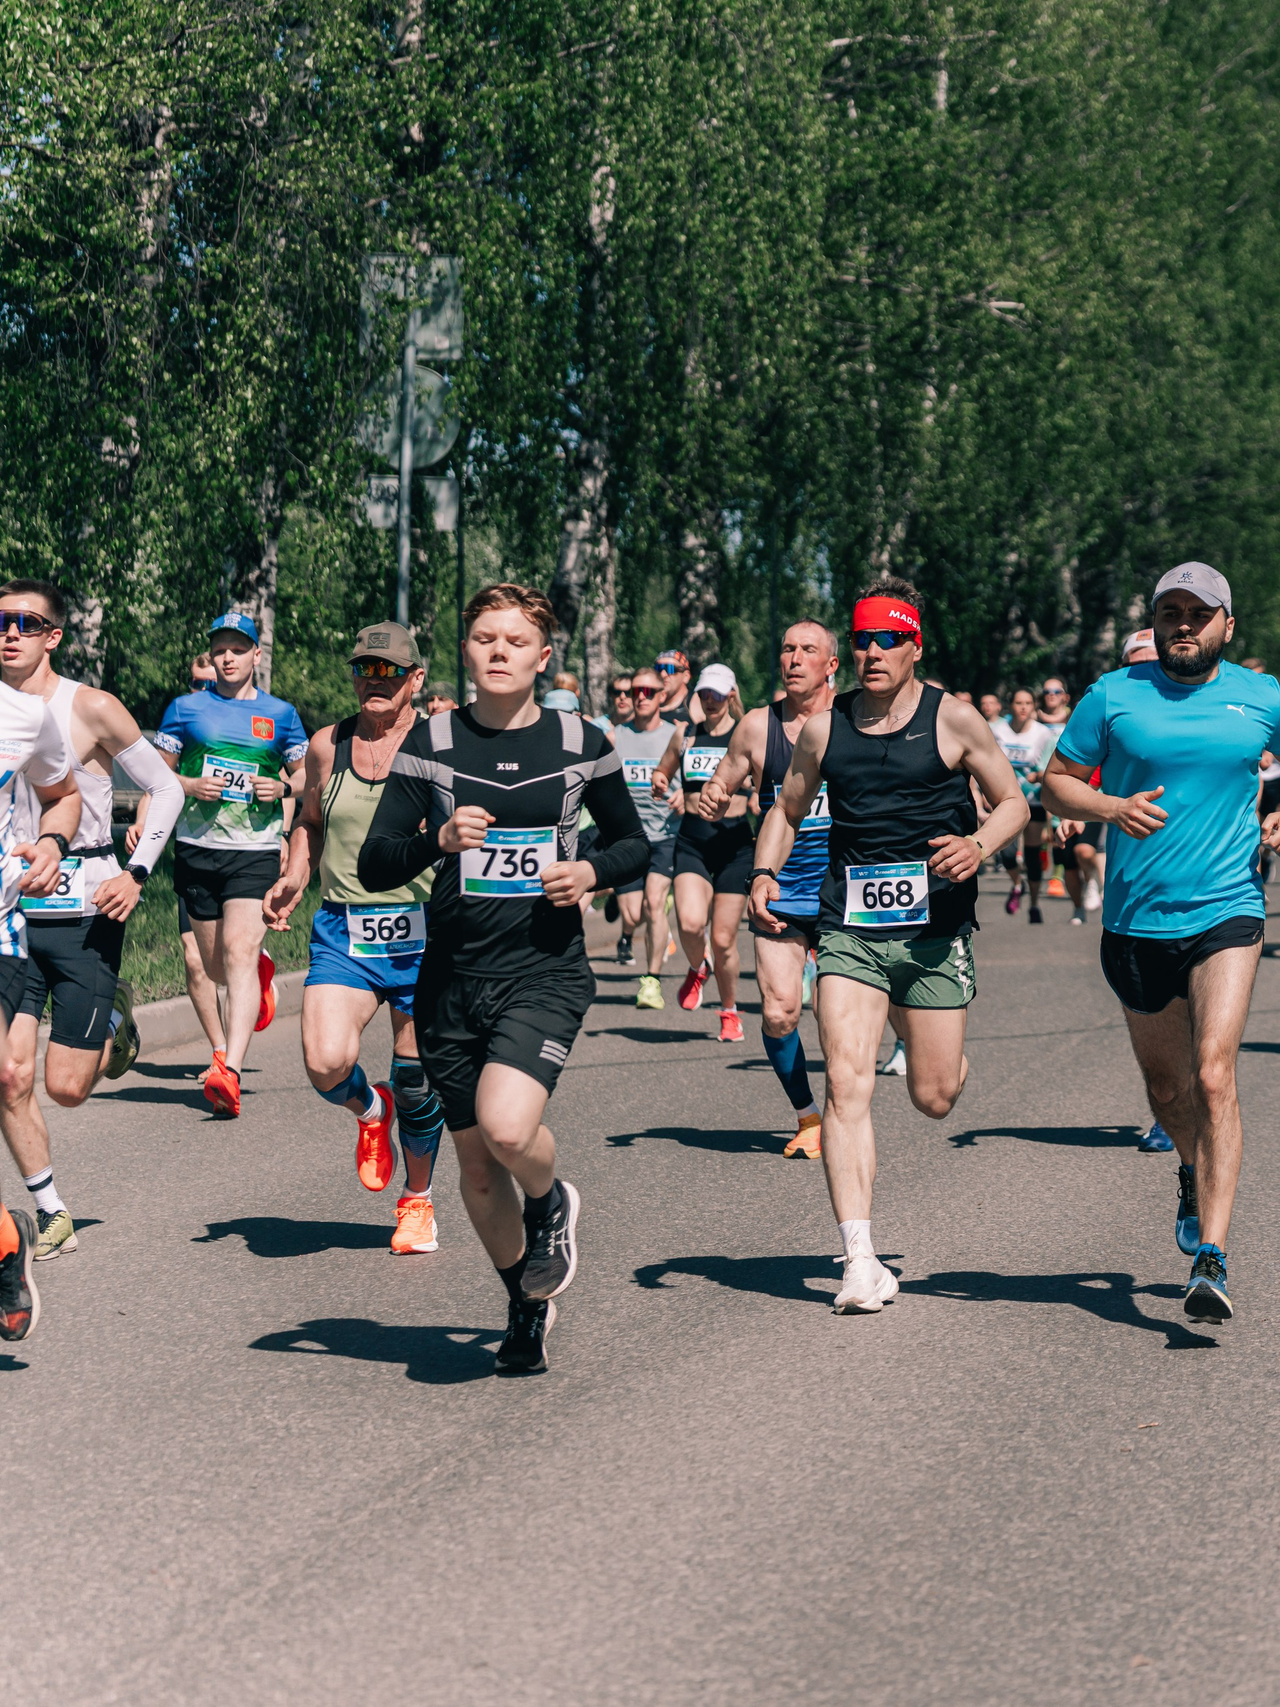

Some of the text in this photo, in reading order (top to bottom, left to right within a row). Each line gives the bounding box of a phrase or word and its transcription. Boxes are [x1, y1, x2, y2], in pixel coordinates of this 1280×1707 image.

[691, 756, 721, 770] 872
[480, 847, 539, 878] 736
[862, 880, 915, 910] 668
[362, 915, 411, 942] 569
